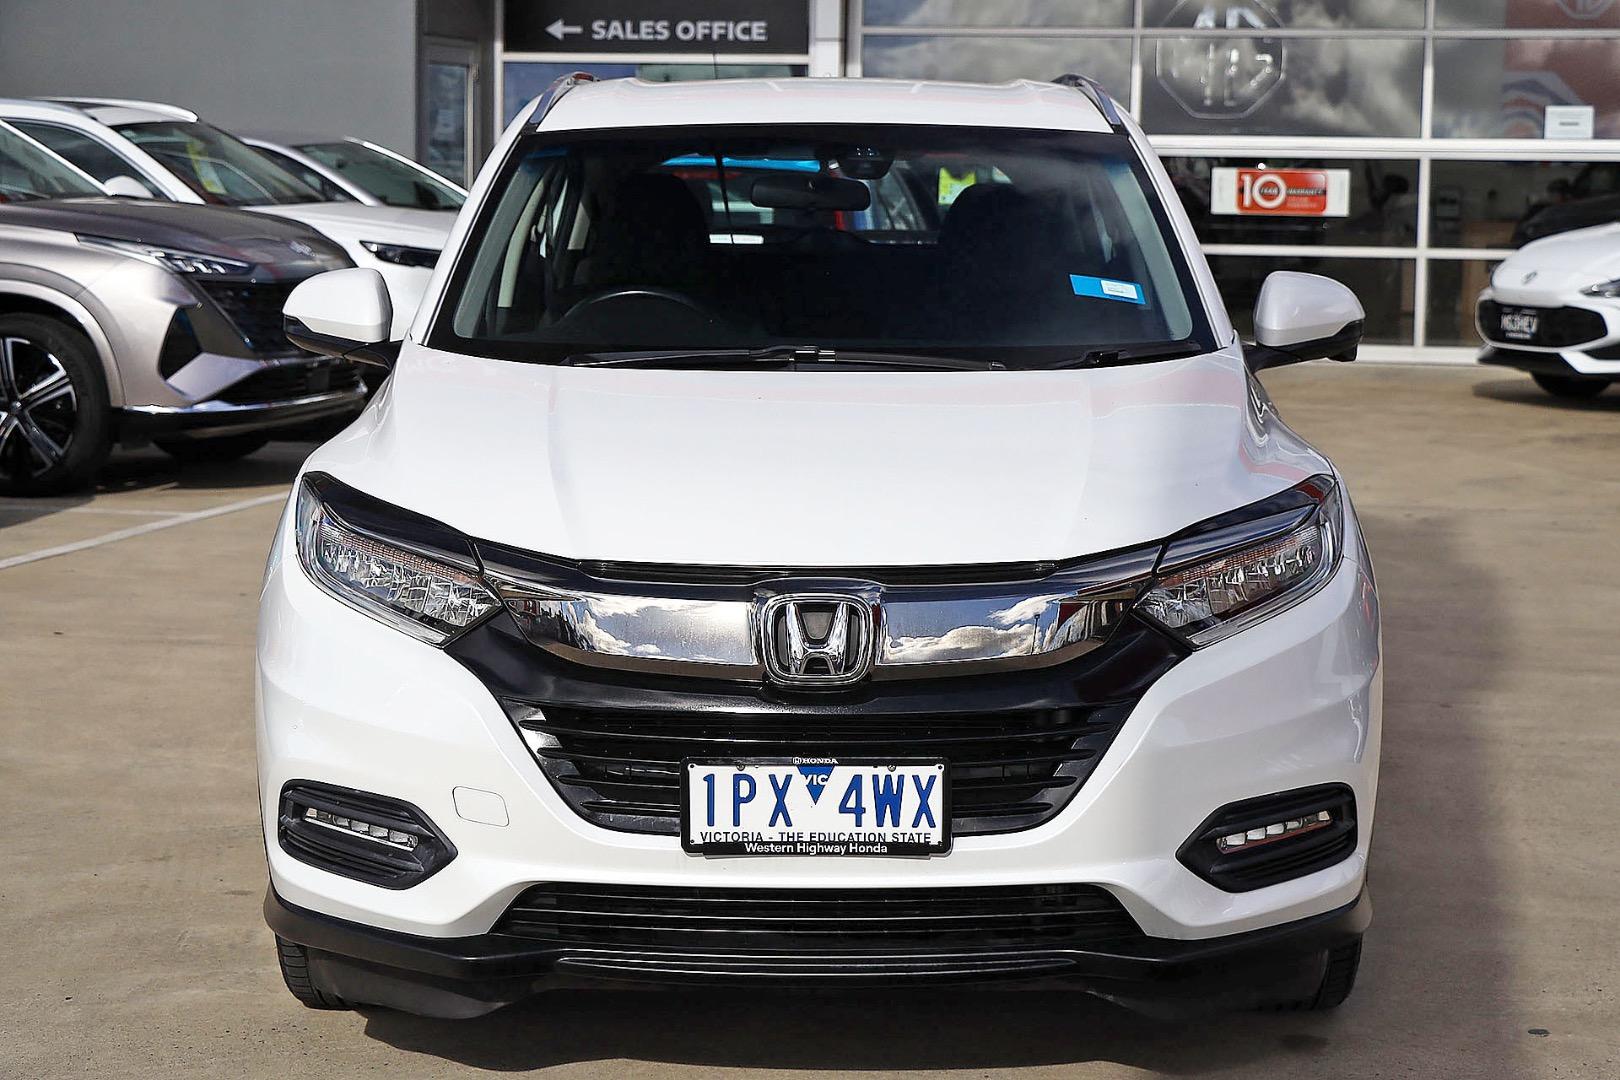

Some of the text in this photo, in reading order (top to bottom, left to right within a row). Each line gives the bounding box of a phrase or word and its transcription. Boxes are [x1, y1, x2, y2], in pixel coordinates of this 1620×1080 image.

[591, 20, 768, 41] SALES OFFICE
[1241, 173, 1286, 209] 10
[803, 774, 829, 786] VIC
[702, 773, 937, 828] 1PX 4WX
[700, 832, 763, 842] VICTORIA
[778, 832, 804, 842] THE
[809, 832, 886, 843] EDUCATION
[891, 833, 931, 843] STATE
[745, 843, 888, 855] Western Highway Honda
